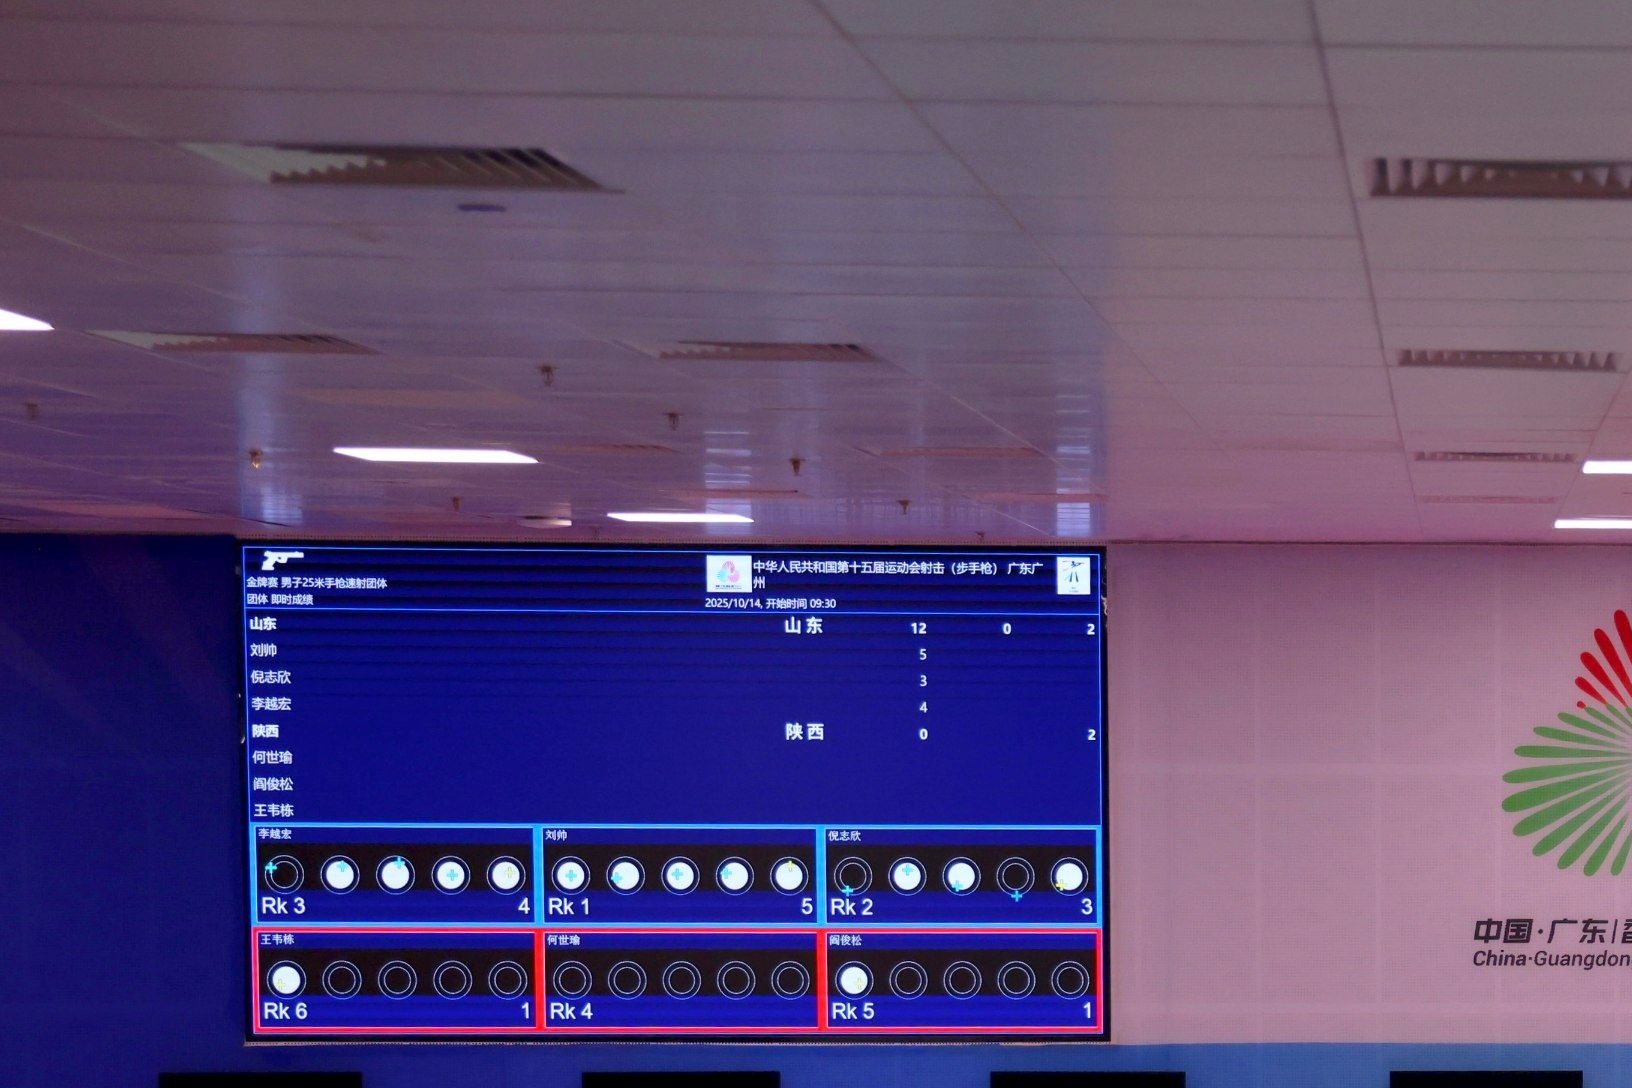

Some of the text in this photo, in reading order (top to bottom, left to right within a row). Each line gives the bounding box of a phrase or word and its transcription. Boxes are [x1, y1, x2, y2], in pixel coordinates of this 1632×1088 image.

[1007, 561, 1044, 576] 广东广
[247, 576, 388, 590] 金牌赛 男子25米手枪速射团体
[752, 575, 766, 589] 州
[246, 593, 314, 606] 团体 即时成绩
[704, 597, 837, 610] 2025/10/14, 开始时间 09:30
[249, 616, 277, 631] 山东
[910, 622, 927, 635] 12
[1002, 622, 1012, 635] 0
[1086, 623, 1096, 636] 2
[249, 642, 278, 658] 刘帅
[919, 648, 927, 661] 5
[250, 669, 292, 685] 倪志欣
[919, 674, 928, 687] 3
[251, 696, 292, 711] 李越宏
[919, 701, 929, 713] 4
[251, 723, 280, 738] 陕西
[919, 728, 929, 741] 0
[1087, 728, 1097, 741] 2
[252, 749, 293, 765] 何世瑜
[253, 776, 294, 792] 阎俊松
[253, 802, 295, 818] 王韦栋
[258, 829, 292, 840] 李越宏
[546, 830, 567, 841] 刘帅
[829, 831, 861, 842] 倪志欣
[261, 896, 306, 915] Rk 3
[517, 897, 531, 915] 4
[548, 897, 589, 915] Rk 1
[801, 897, 814, 915] 5
[830, 897, 874, 916] Rk 2
[1081, 897, 1093, 916] 3
[261, 934, 294, 945] 王韦栋
[263, 1001, 308, 1020] Rk 6
[521, 1001, 530, 1019] 1
[550, 1002, 594, 1020] Rk 4
[832, 1002, 875, 1020] Rk 5
[1083, 1001, 1091, 1019] 1
